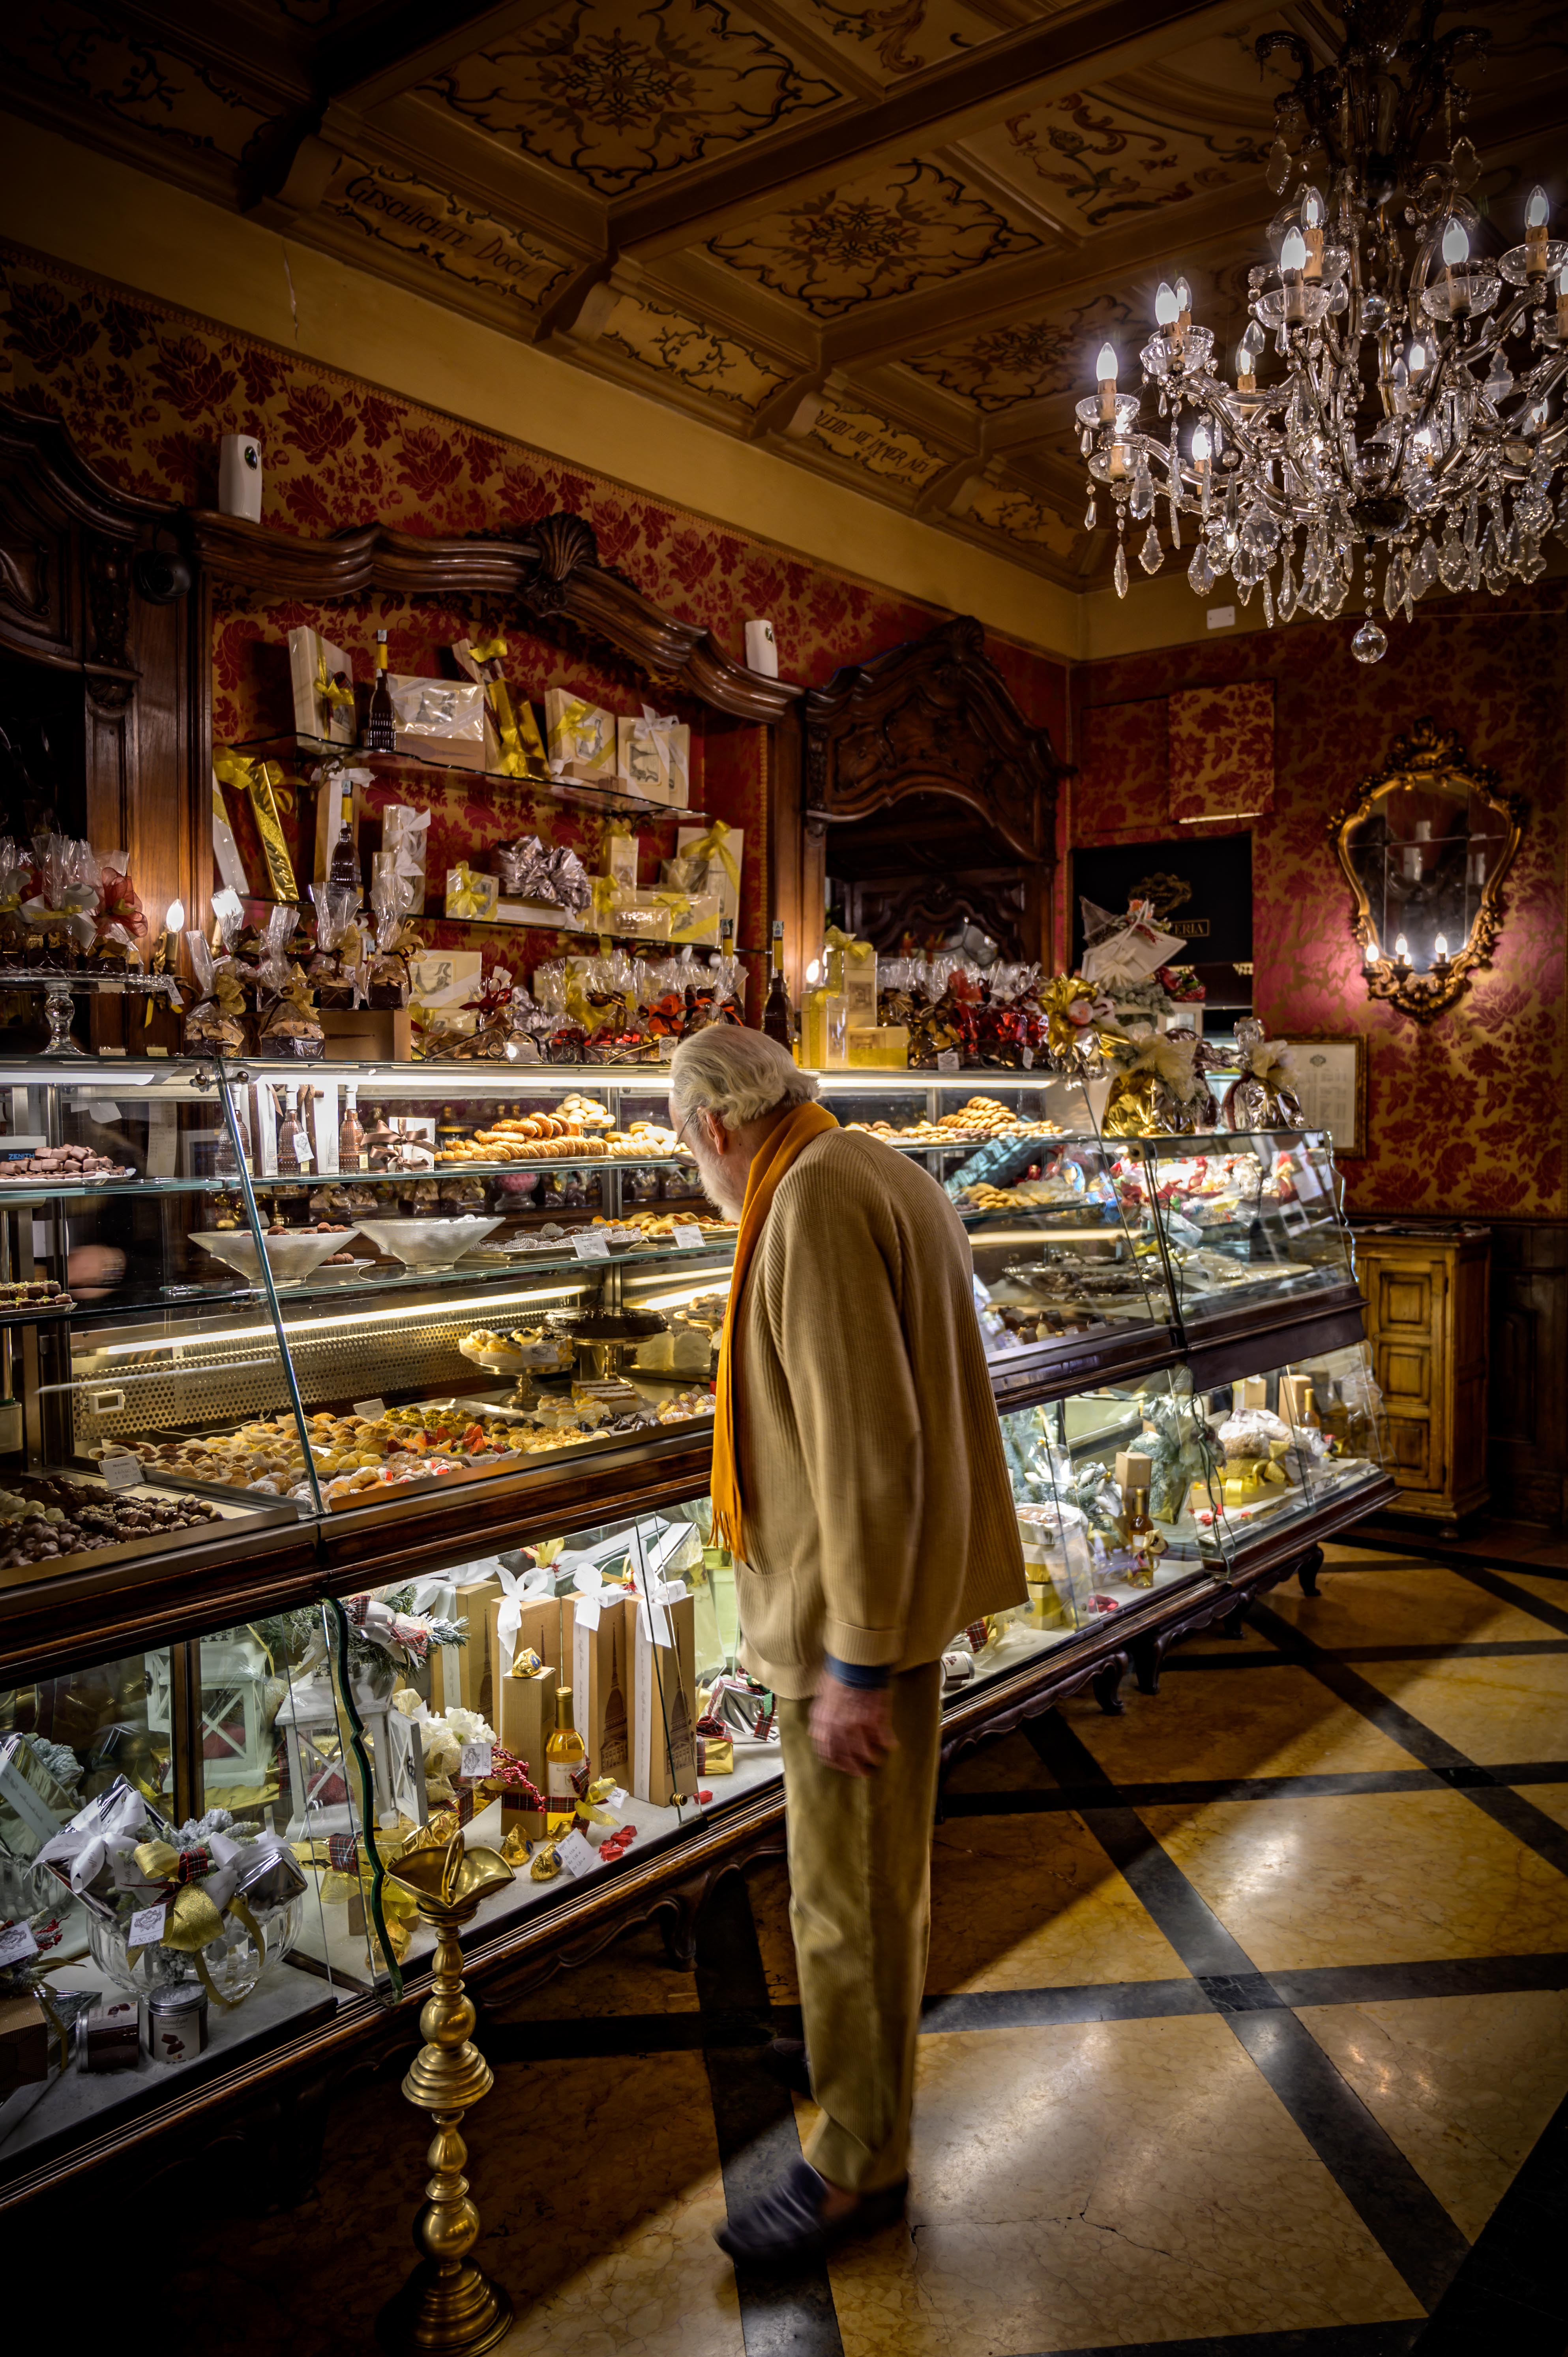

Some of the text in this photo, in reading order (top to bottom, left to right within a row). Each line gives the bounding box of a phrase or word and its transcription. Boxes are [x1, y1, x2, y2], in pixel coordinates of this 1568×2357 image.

[345, 176, 545, 279] GESCHICHTE DOCH
[1171, 923, 1204, 934] ERIA
